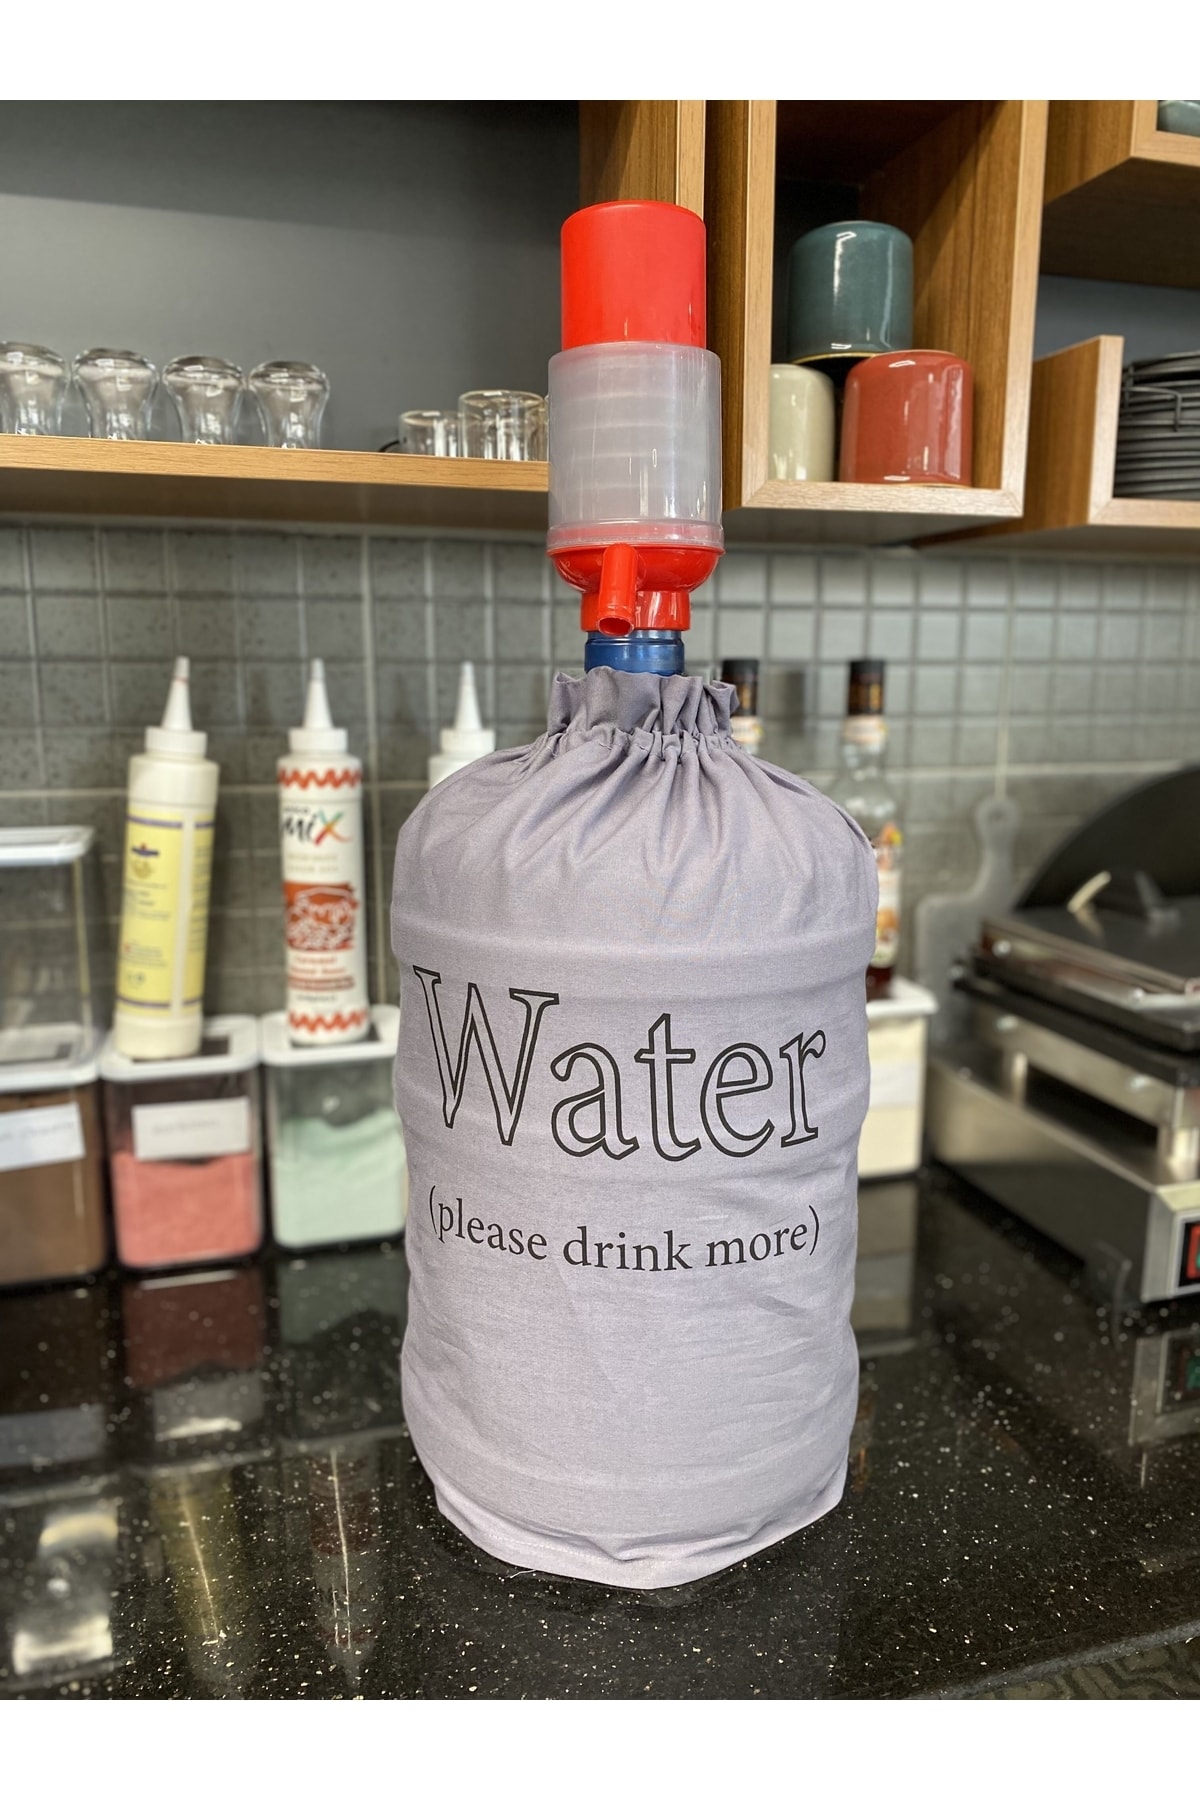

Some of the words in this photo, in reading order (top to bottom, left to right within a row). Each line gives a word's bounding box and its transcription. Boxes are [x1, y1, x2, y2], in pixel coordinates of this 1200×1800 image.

[412, 964, 827, 1162] Water
[429, 1185, 548, 1261] (please
[563, 1226, 693, 1272] drink
[704, 1205, 820, 1267] more)
